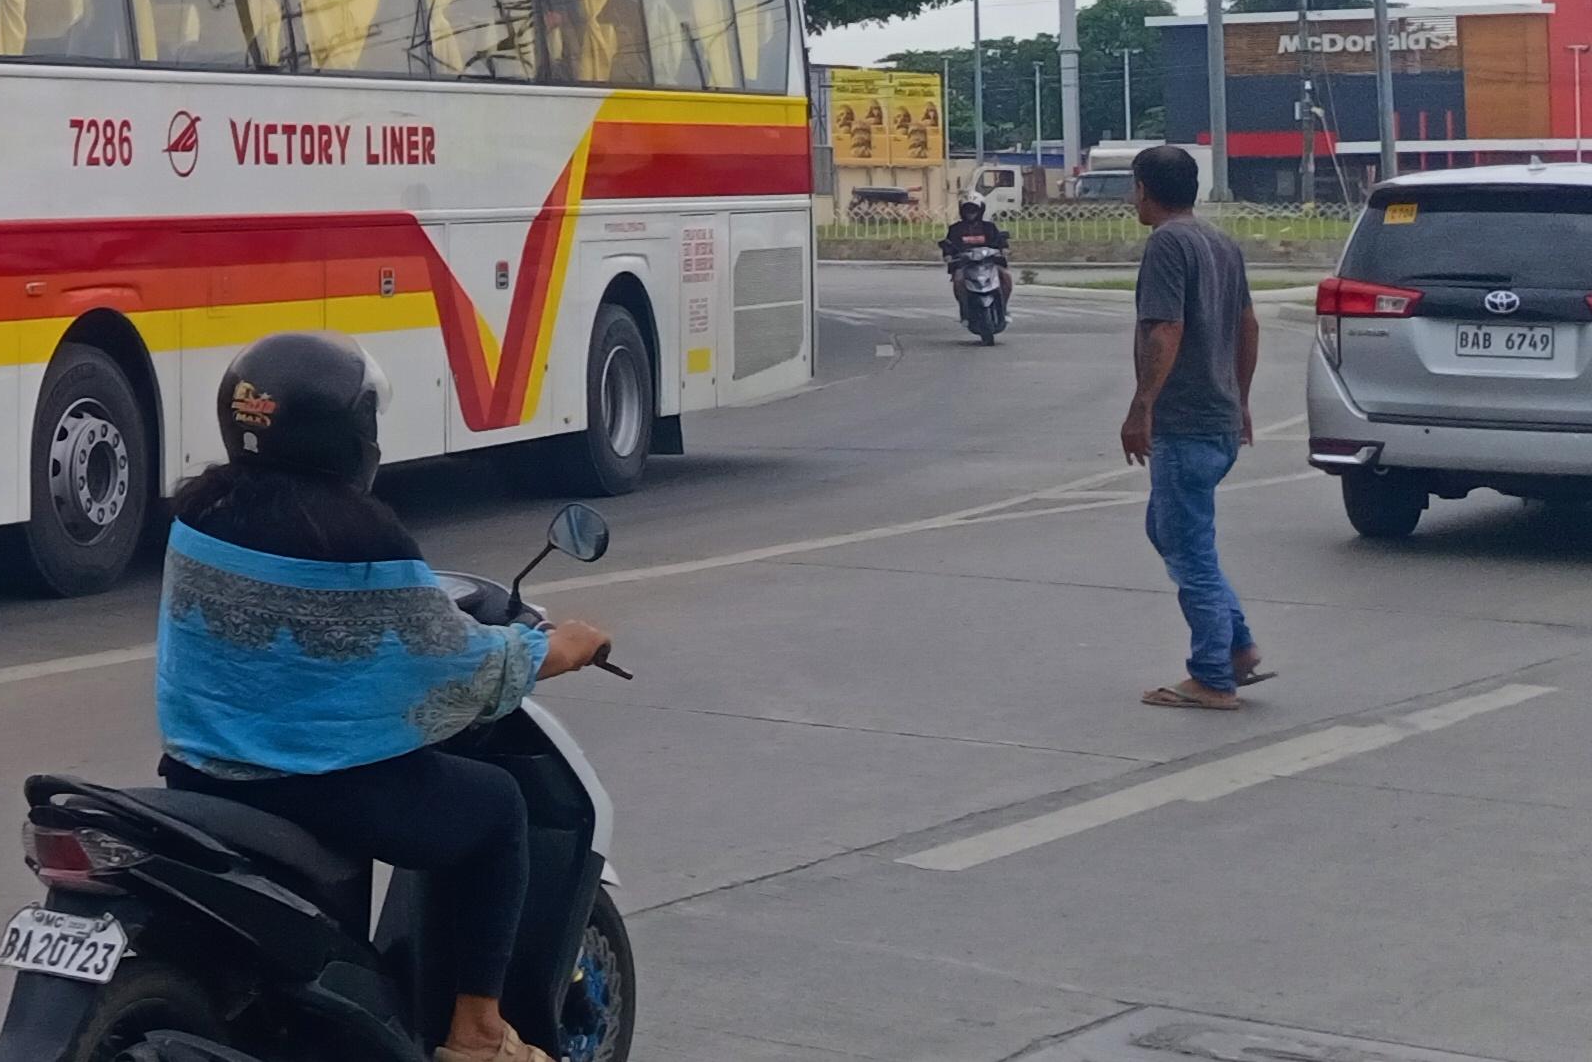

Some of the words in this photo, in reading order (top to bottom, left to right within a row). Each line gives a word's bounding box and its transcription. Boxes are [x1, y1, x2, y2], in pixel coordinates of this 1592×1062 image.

[69, 119, 132, 167] 7286
[230, 118, 351, 165] VICTORY
[366, 125, 436, 165] LINER
[1460, 331, 1492, 349] BAB
[1505, 332, 1550, 351] 6749
